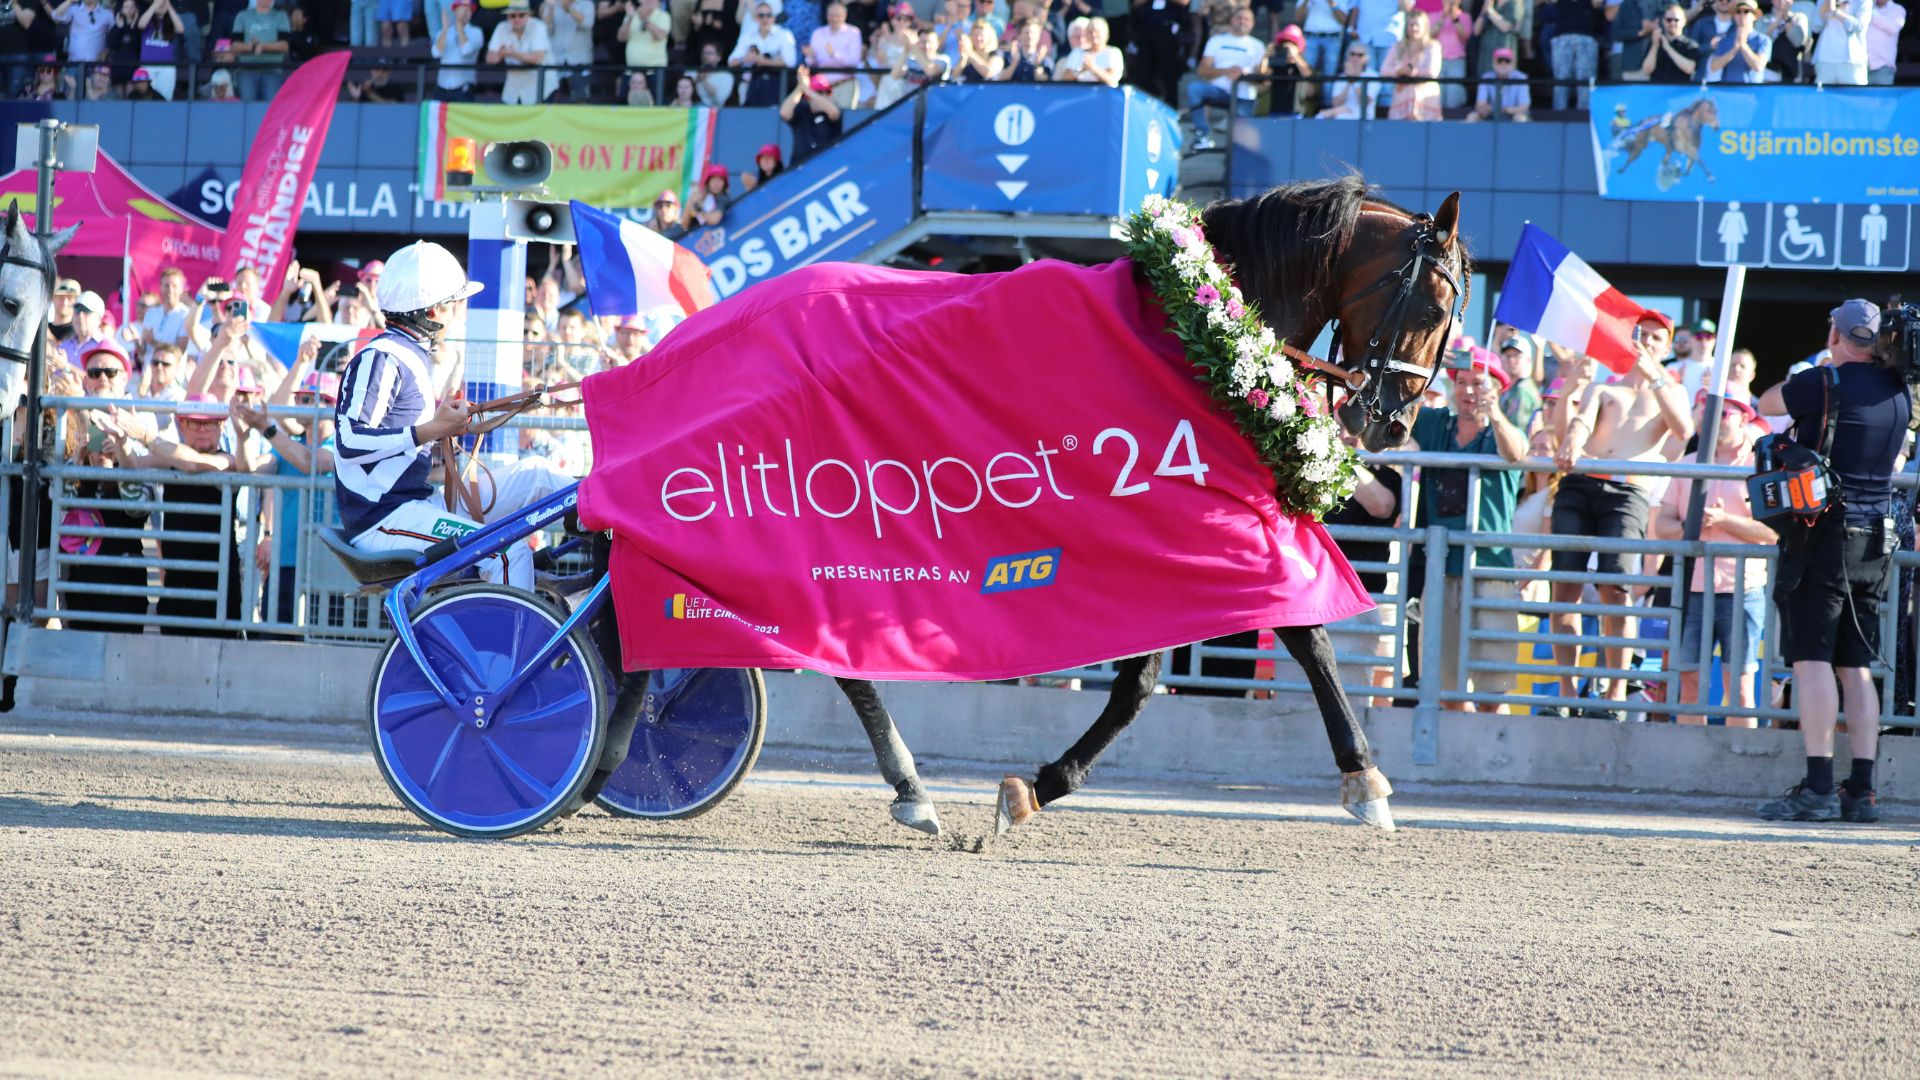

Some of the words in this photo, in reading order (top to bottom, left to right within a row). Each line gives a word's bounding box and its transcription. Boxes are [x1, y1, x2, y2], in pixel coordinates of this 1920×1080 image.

[579, 144, 612, 172] ON
[622, 143, 684, 172] FIRE
[1719, 130, 1920, 161] Stjärnblomste
[200, 178, 397, 219] SALLA
[258, 125, 314, 291] CHANDISE
[709, 237, 774, 303] DS
[769, 181, 870, 261] BAR
[1092, 418, 1210, 497] 24
[434, 521, 464, 537] Paris
[811, 565, 942, 583] PRESENTERAS
[948, 570, 970, 584] AV
[985, 555, 1053, 587] ATG
[685, 597, 709, 608] UET
[686, 608, 712, 619] ELITE
[754, 625, 780, 635] 2024
